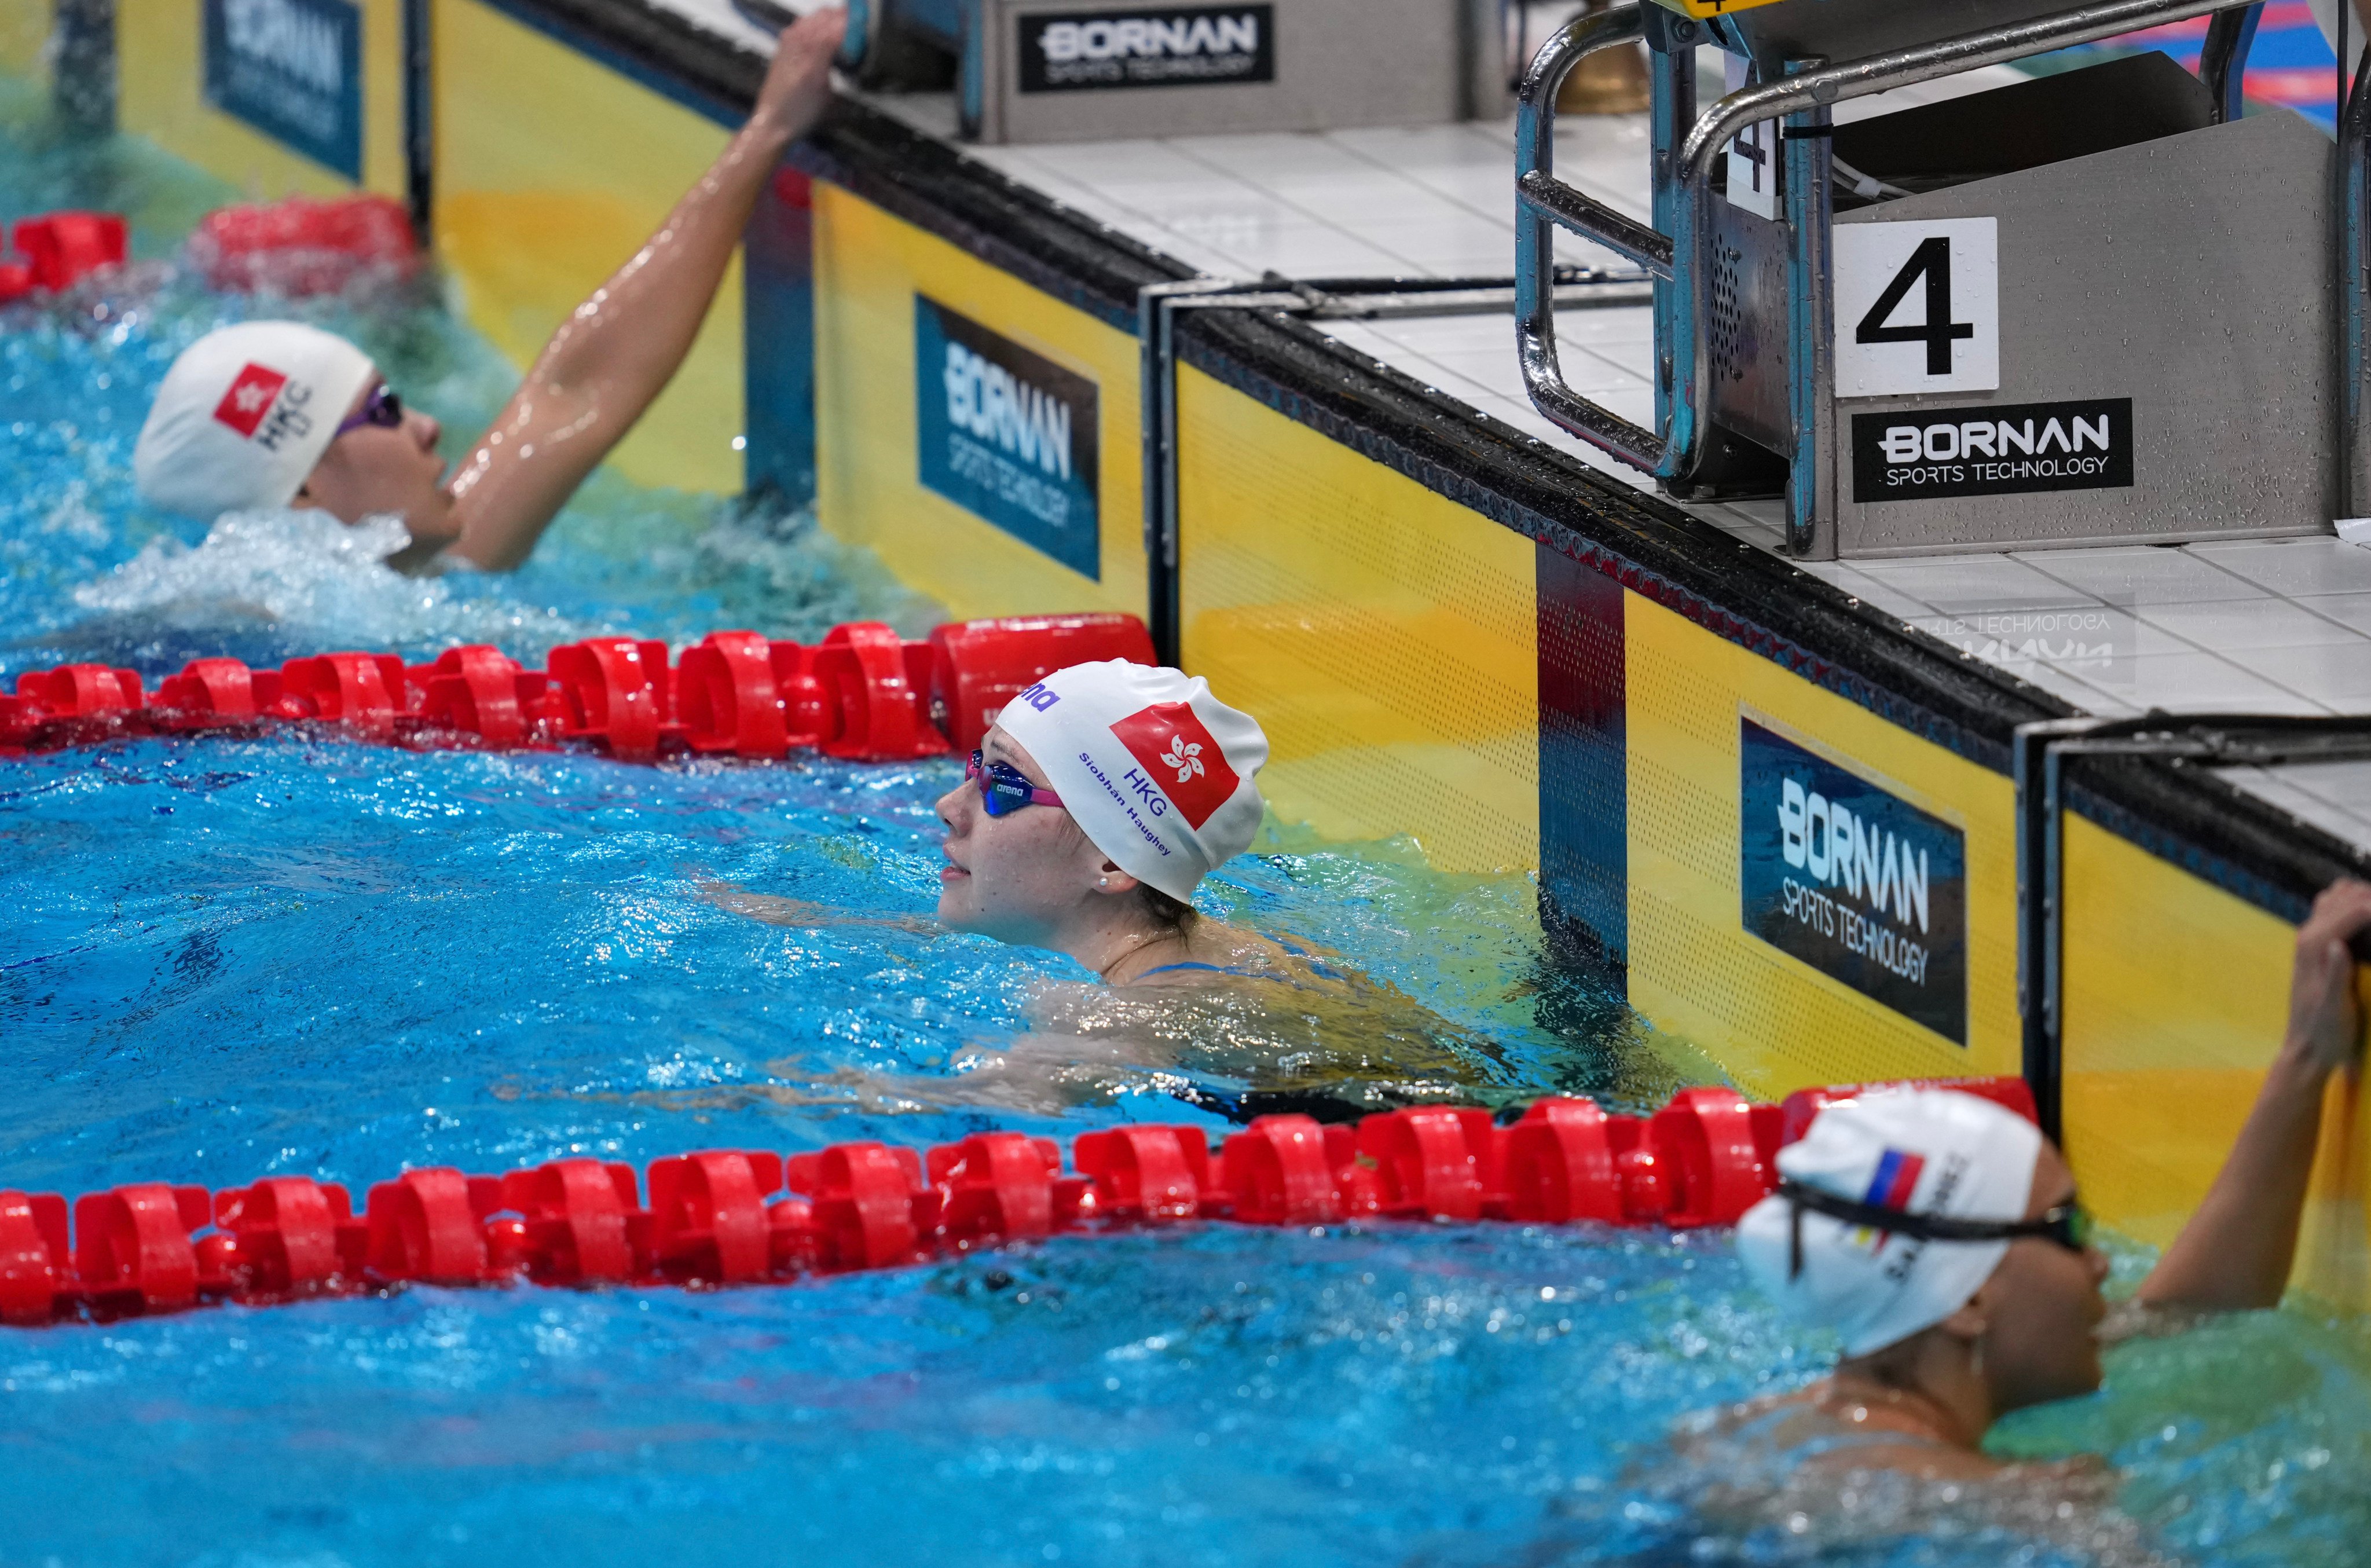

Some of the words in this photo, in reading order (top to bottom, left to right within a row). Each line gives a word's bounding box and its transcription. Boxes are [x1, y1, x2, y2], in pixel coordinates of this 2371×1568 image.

[1038, 13, 1258, 61] BORNAN
[1856, 236, 1973, 375] 4
[943, 340, 1071, 482] BORNAN
[1878, 414, 2109, 463] BORNAN
[1886, 465, 1965, 486] SPORTS
[1971, 456, 2109, 481] TECHNOLOGY
[996, 784, 1024, 797] arena
[1079, 753, 1125, 806] Siobhán
[1127, 807, 1171, 856] Haughey
[1123, 768, 1167, 816] HKG
[1777, 778, 1929, 935] BORNAN
[1783, 876, 1834, 939] SPORTS
[1837, 904, 1929, 987] TECHNOLOGY
